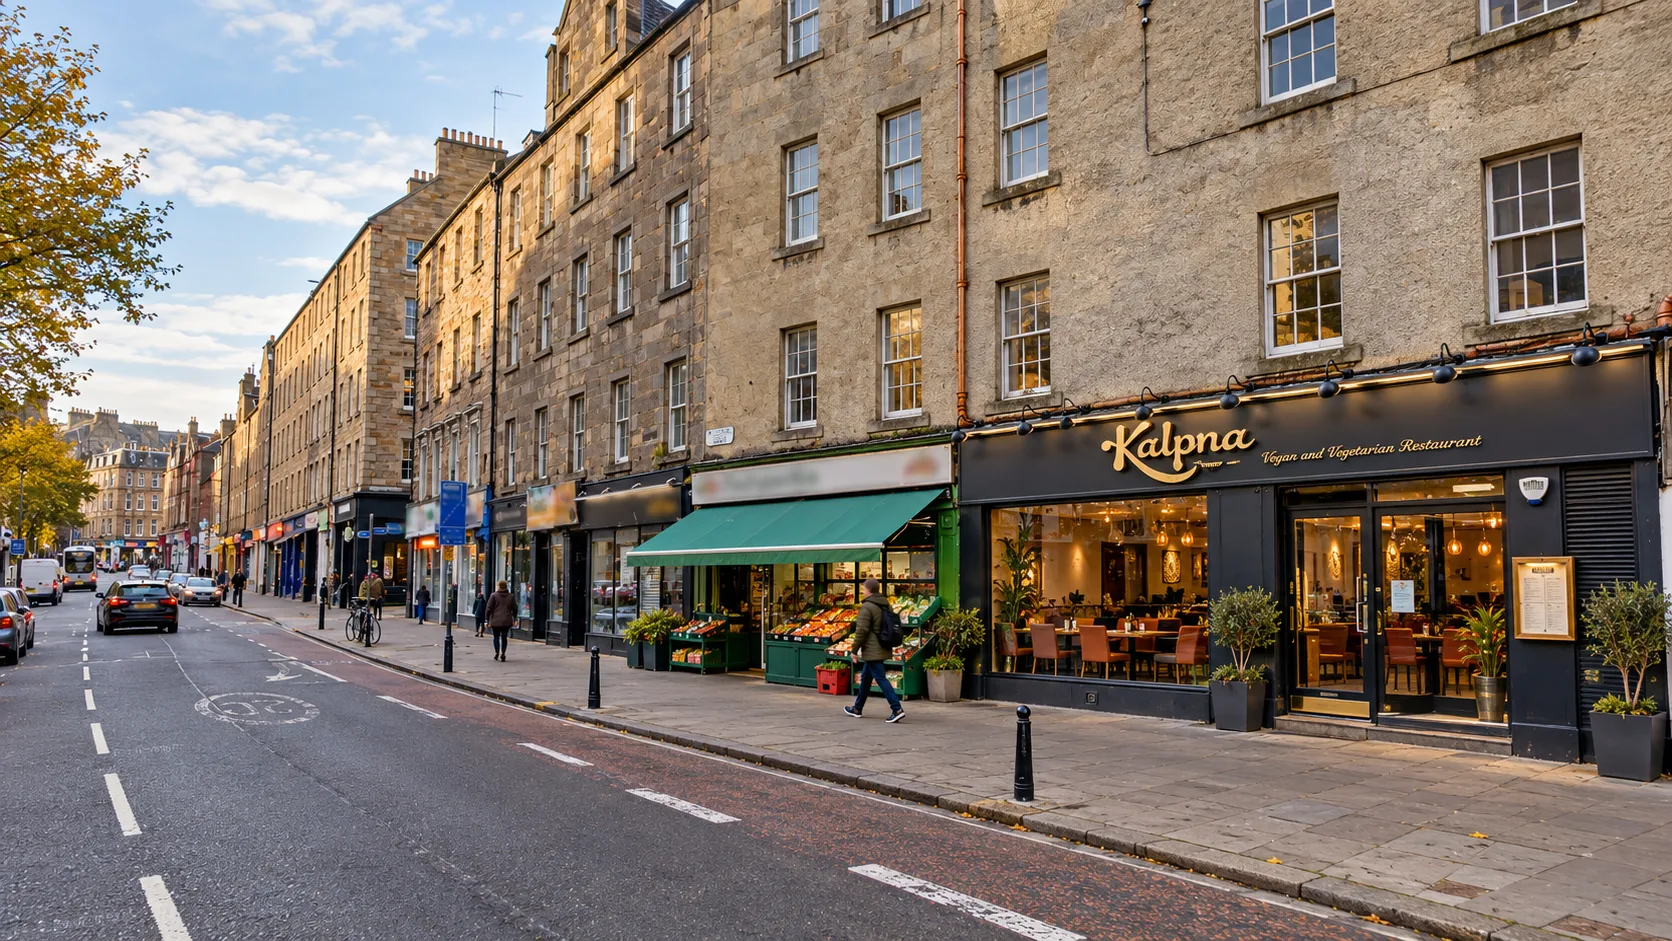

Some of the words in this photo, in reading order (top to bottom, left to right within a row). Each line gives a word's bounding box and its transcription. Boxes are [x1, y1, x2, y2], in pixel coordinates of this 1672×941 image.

[1101, 420, 1256, 483] Kalpna
[1300, 448, 1326, 461] and
[1398, 435, 1482, 452] Restaurant
